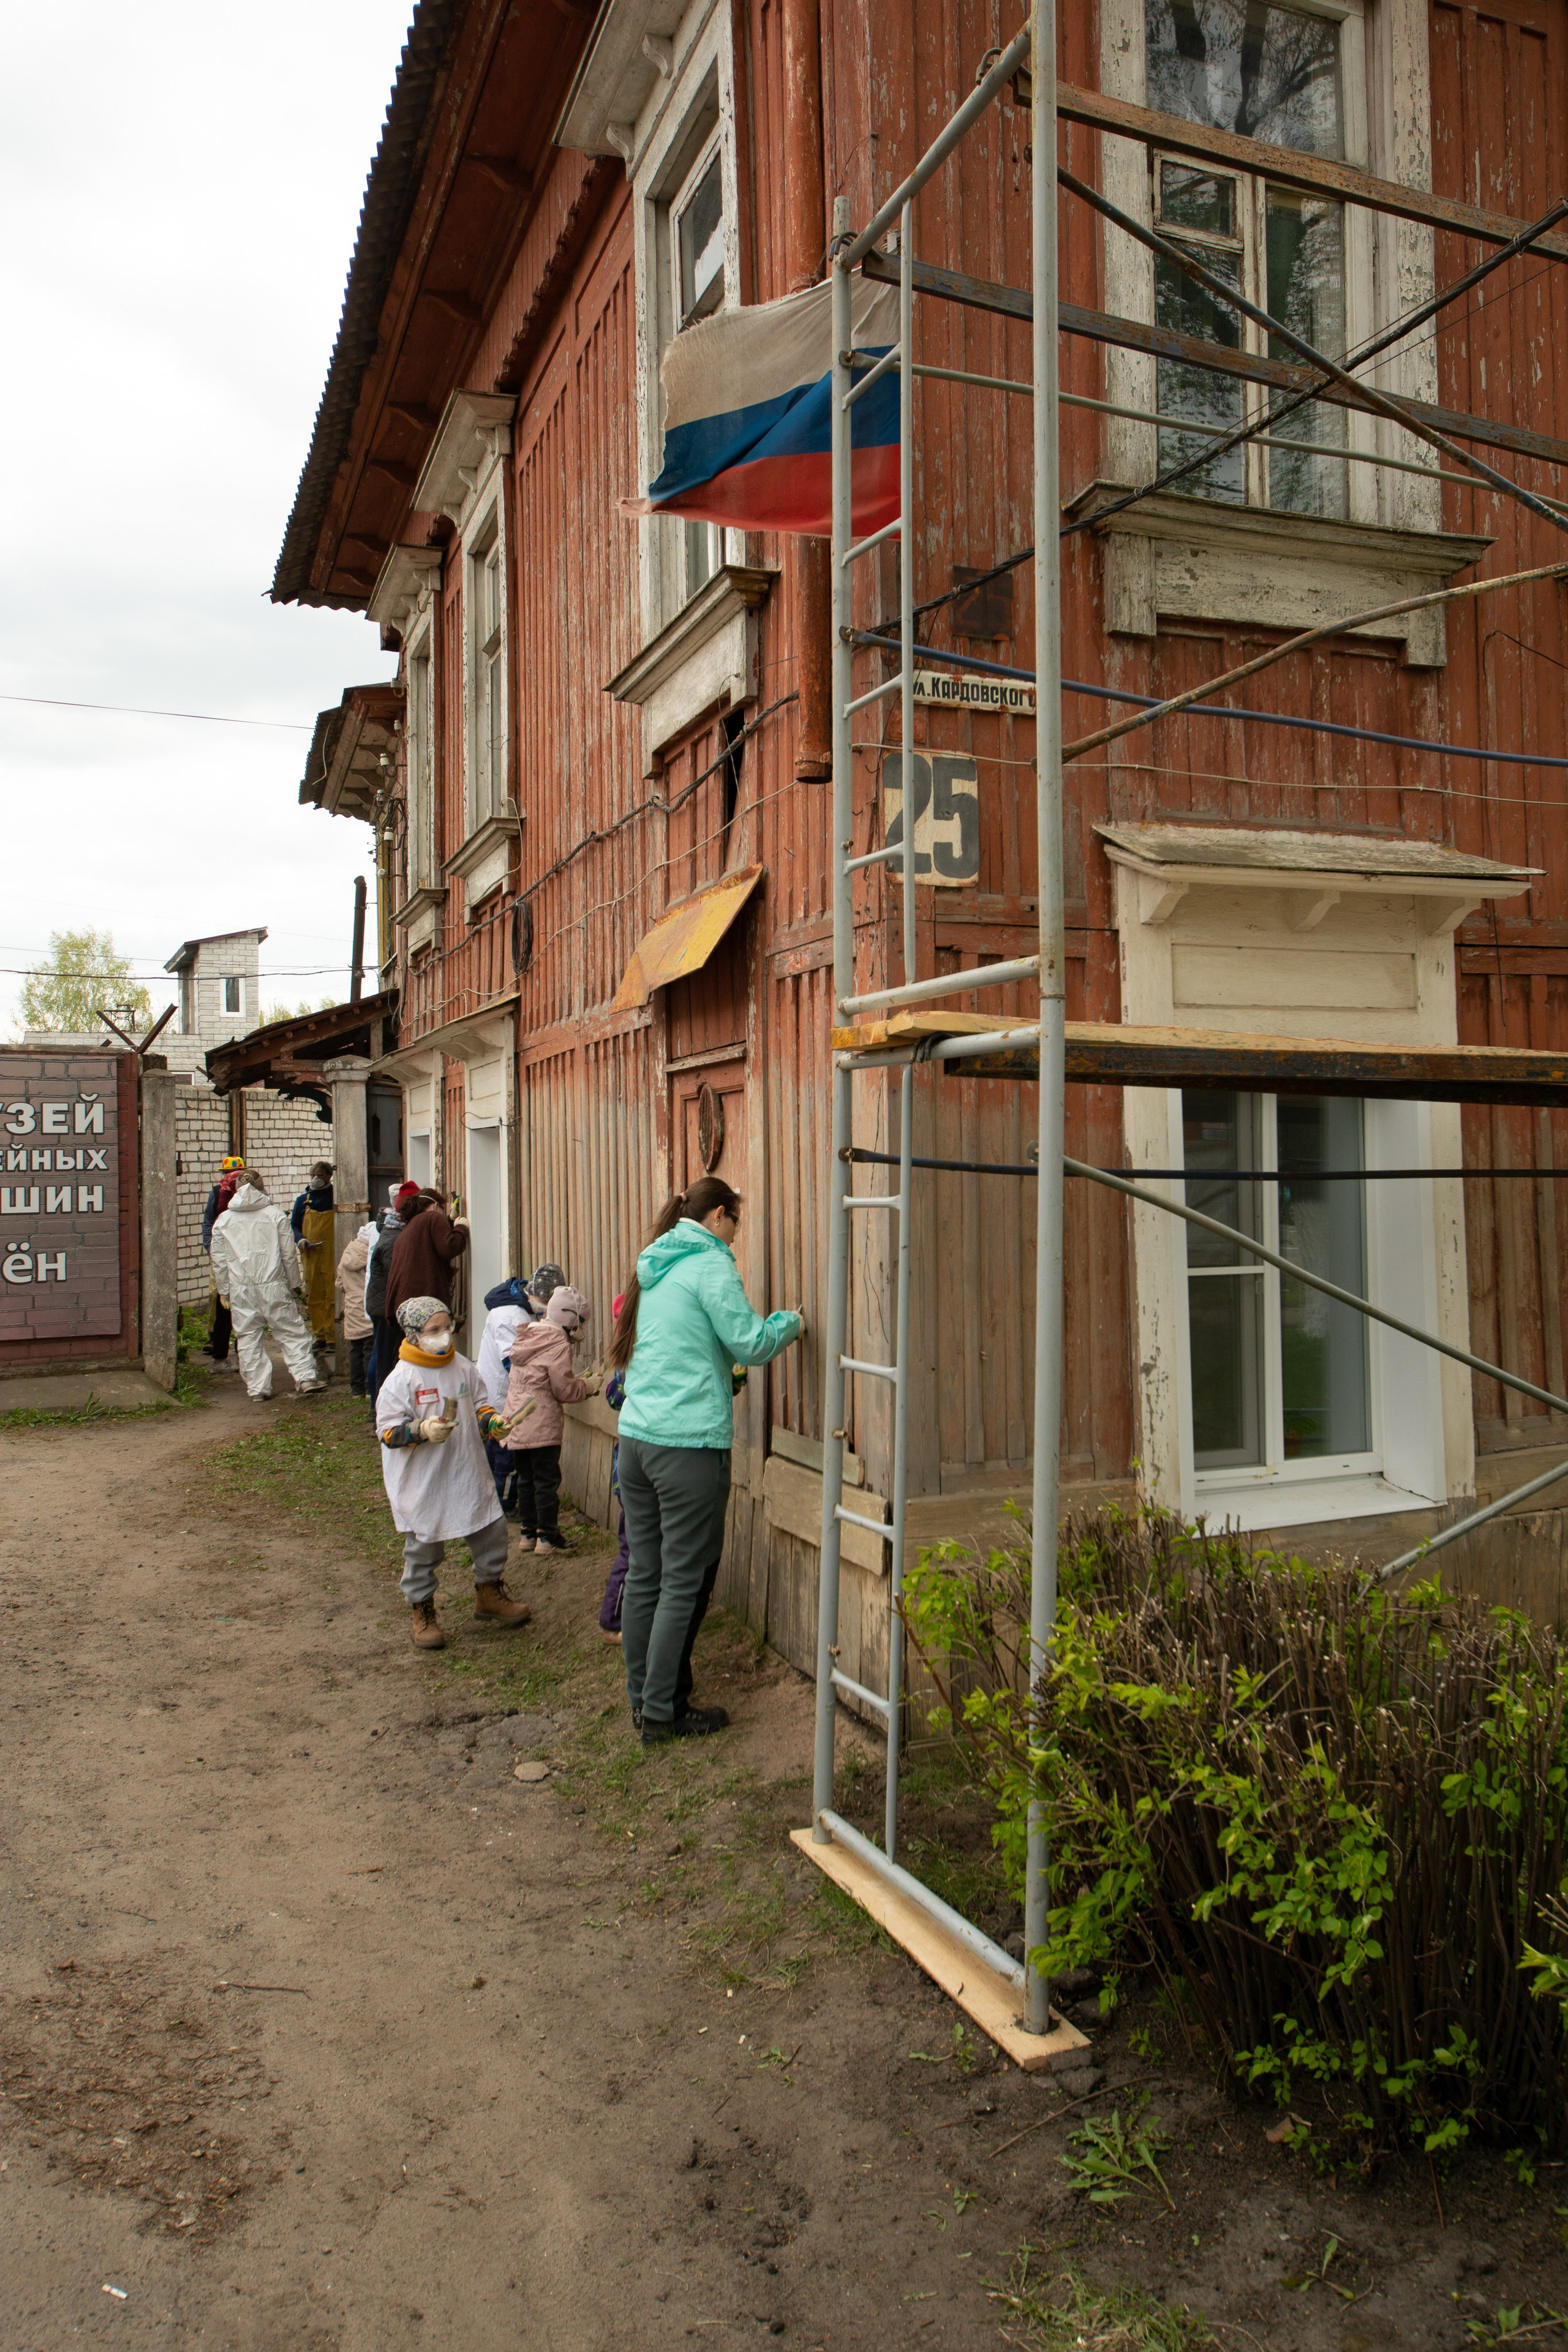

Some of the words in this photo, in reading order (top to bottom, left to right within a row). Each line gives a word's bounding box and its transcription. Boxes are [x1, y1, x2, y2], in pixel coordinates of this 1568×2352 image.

[884, 753, 978, 879] 25
[0, 1093, 105, 1134] ЗЕЙ
[0, 1143, 108, 1171] ЙНЫХ
